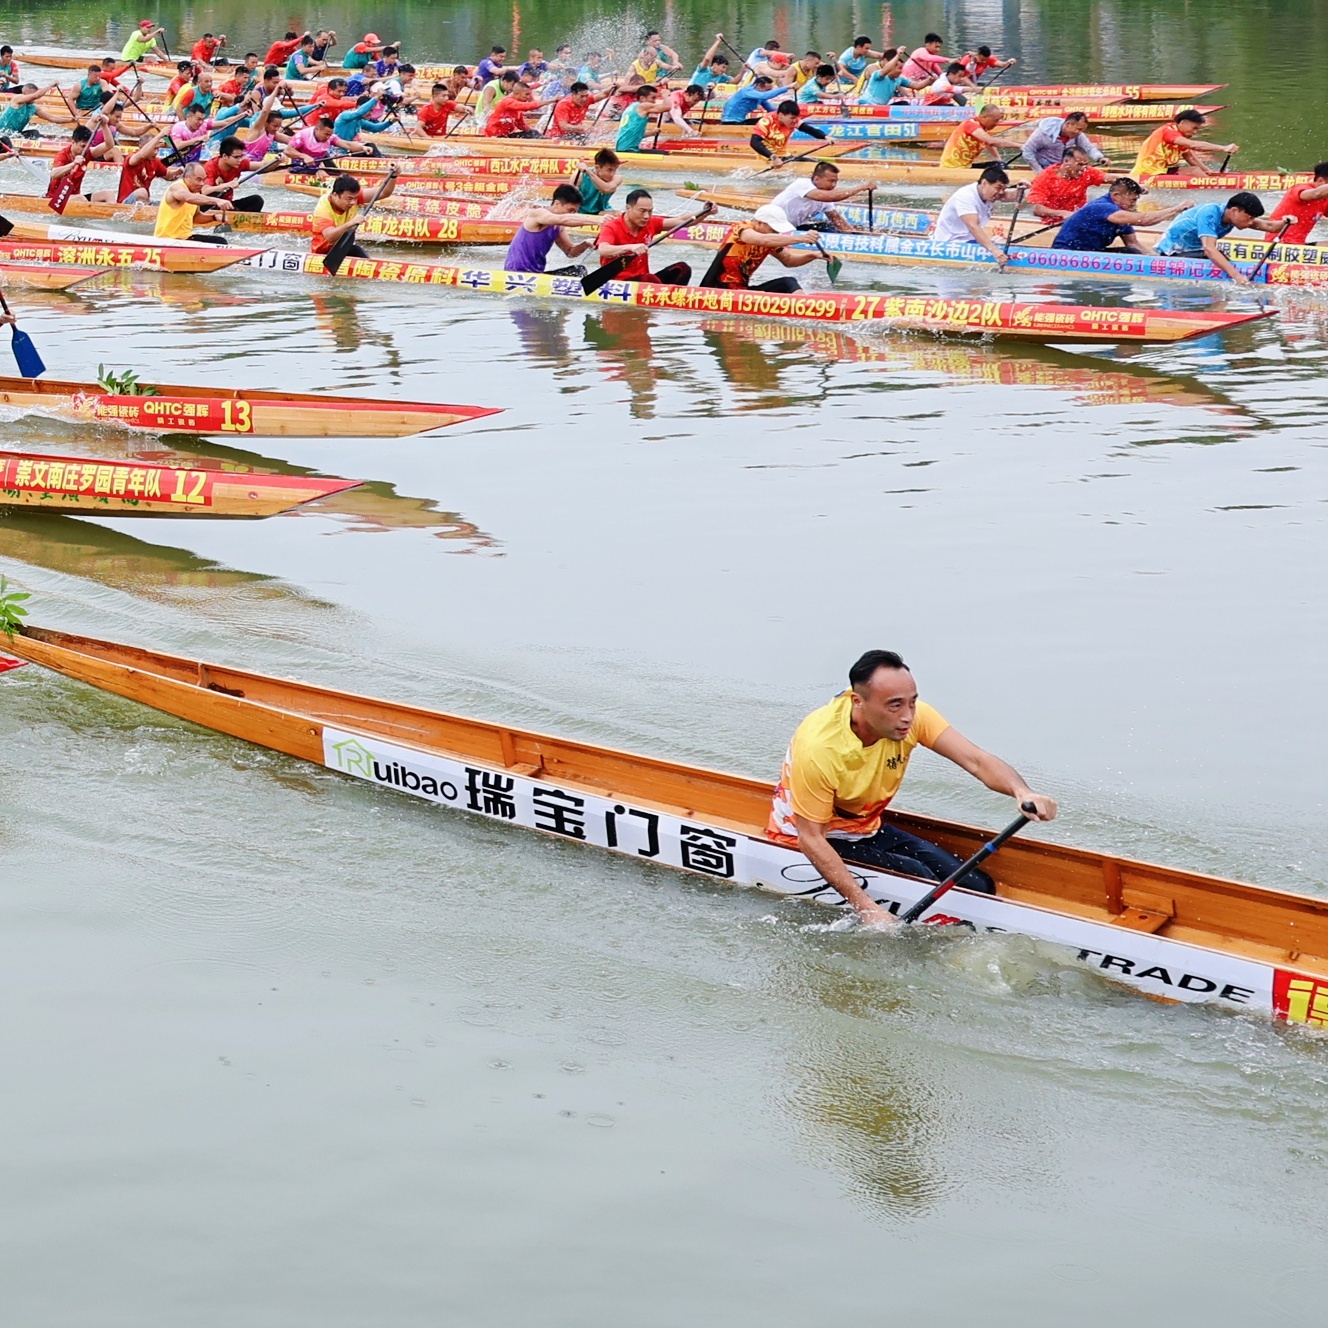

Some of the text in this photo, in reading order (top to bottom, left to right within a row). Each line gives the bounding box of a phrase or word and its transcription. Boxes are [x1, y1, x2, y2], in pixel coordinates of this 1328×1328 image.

[1126, 86, 1140, 100] 55
[903, 124, 917, 137] 51
[437, 219, 459, 239] 28
[143, 247, 163, 268] 25
[737, 292, 836, 319] 13702916299
[852, 295, 881, 320] 27
[220, 400, 252, 432] 13
[14, 459, 161, 498] 崇文南庄罗园青年队
[170, 469, 207, 505] 12
[463, 766, 737, 880] 瑞宝门窗
[1075, 946, 1256, 1005] TRADE
